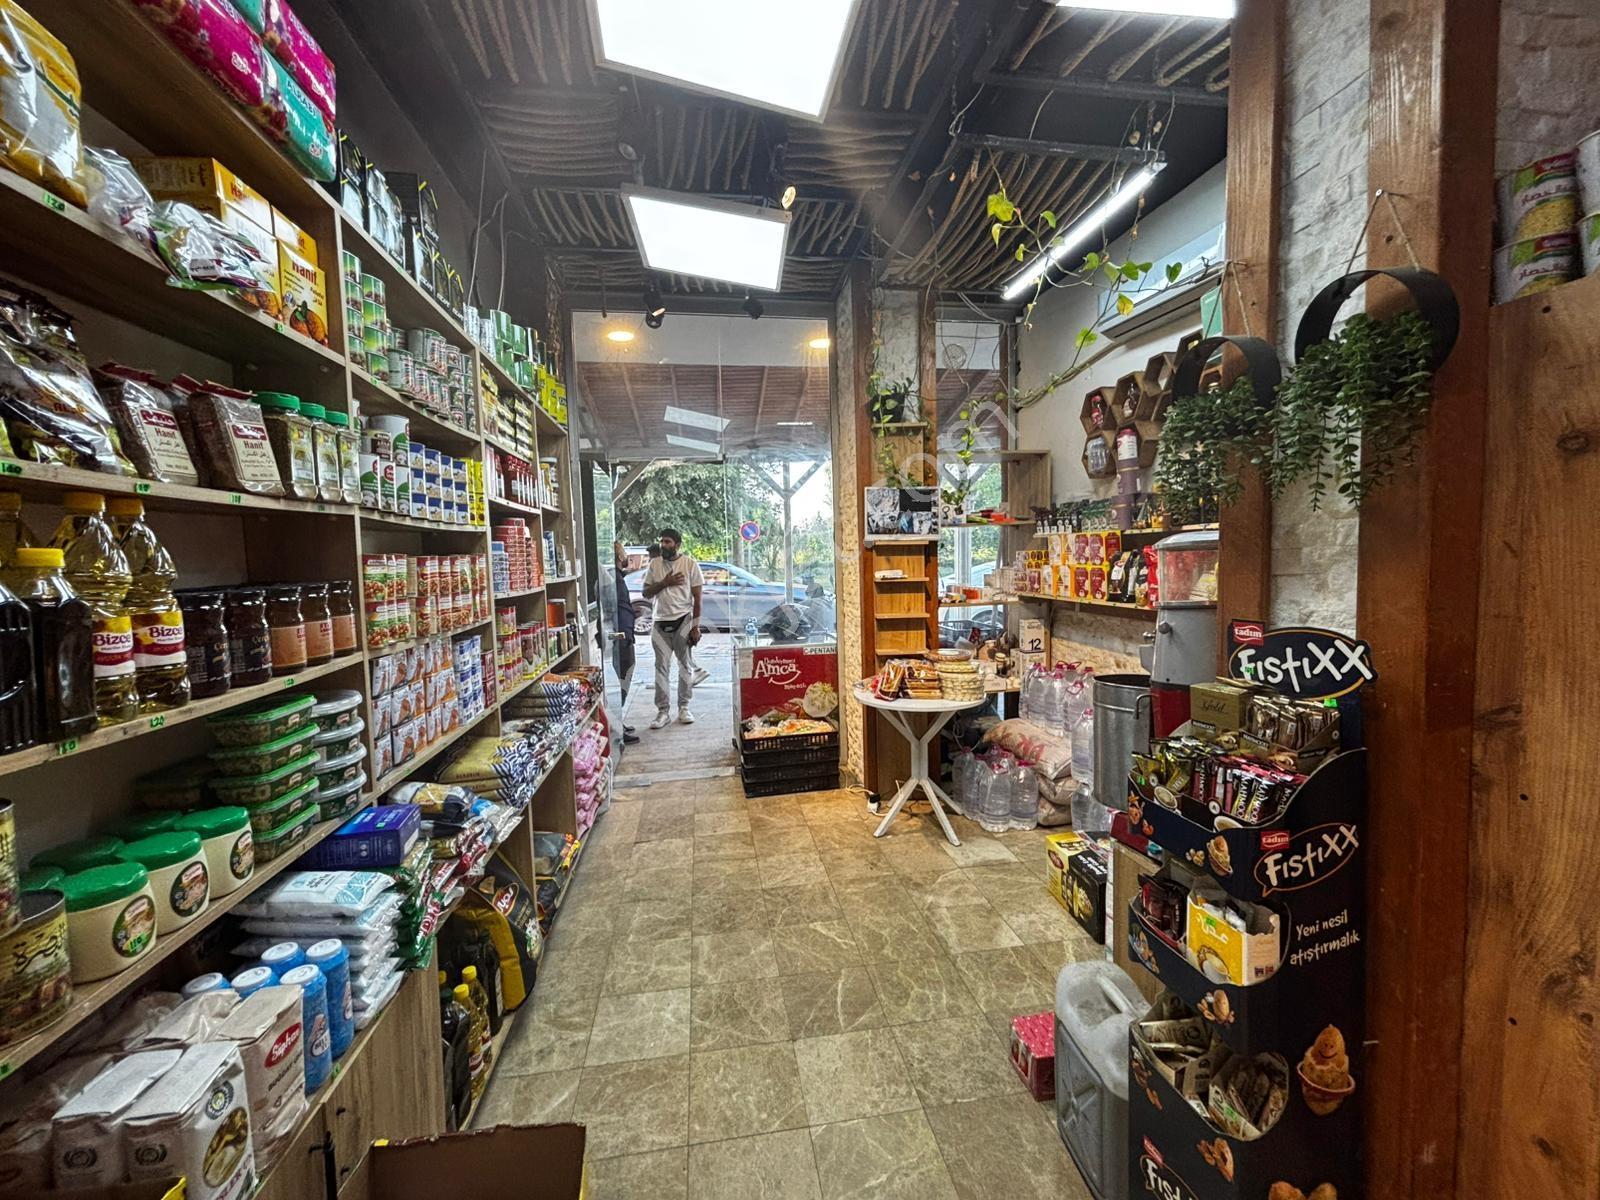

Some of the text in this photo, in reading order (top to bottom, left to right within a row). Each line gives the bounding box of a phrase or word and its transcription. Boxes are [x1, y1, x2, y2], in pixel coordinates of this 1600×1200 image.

[803, 646, 836, 655] C-PENTAN
[1028, 638, 1042, 651] 12
[1296, 909, 1348, 940] Yeni nesil
